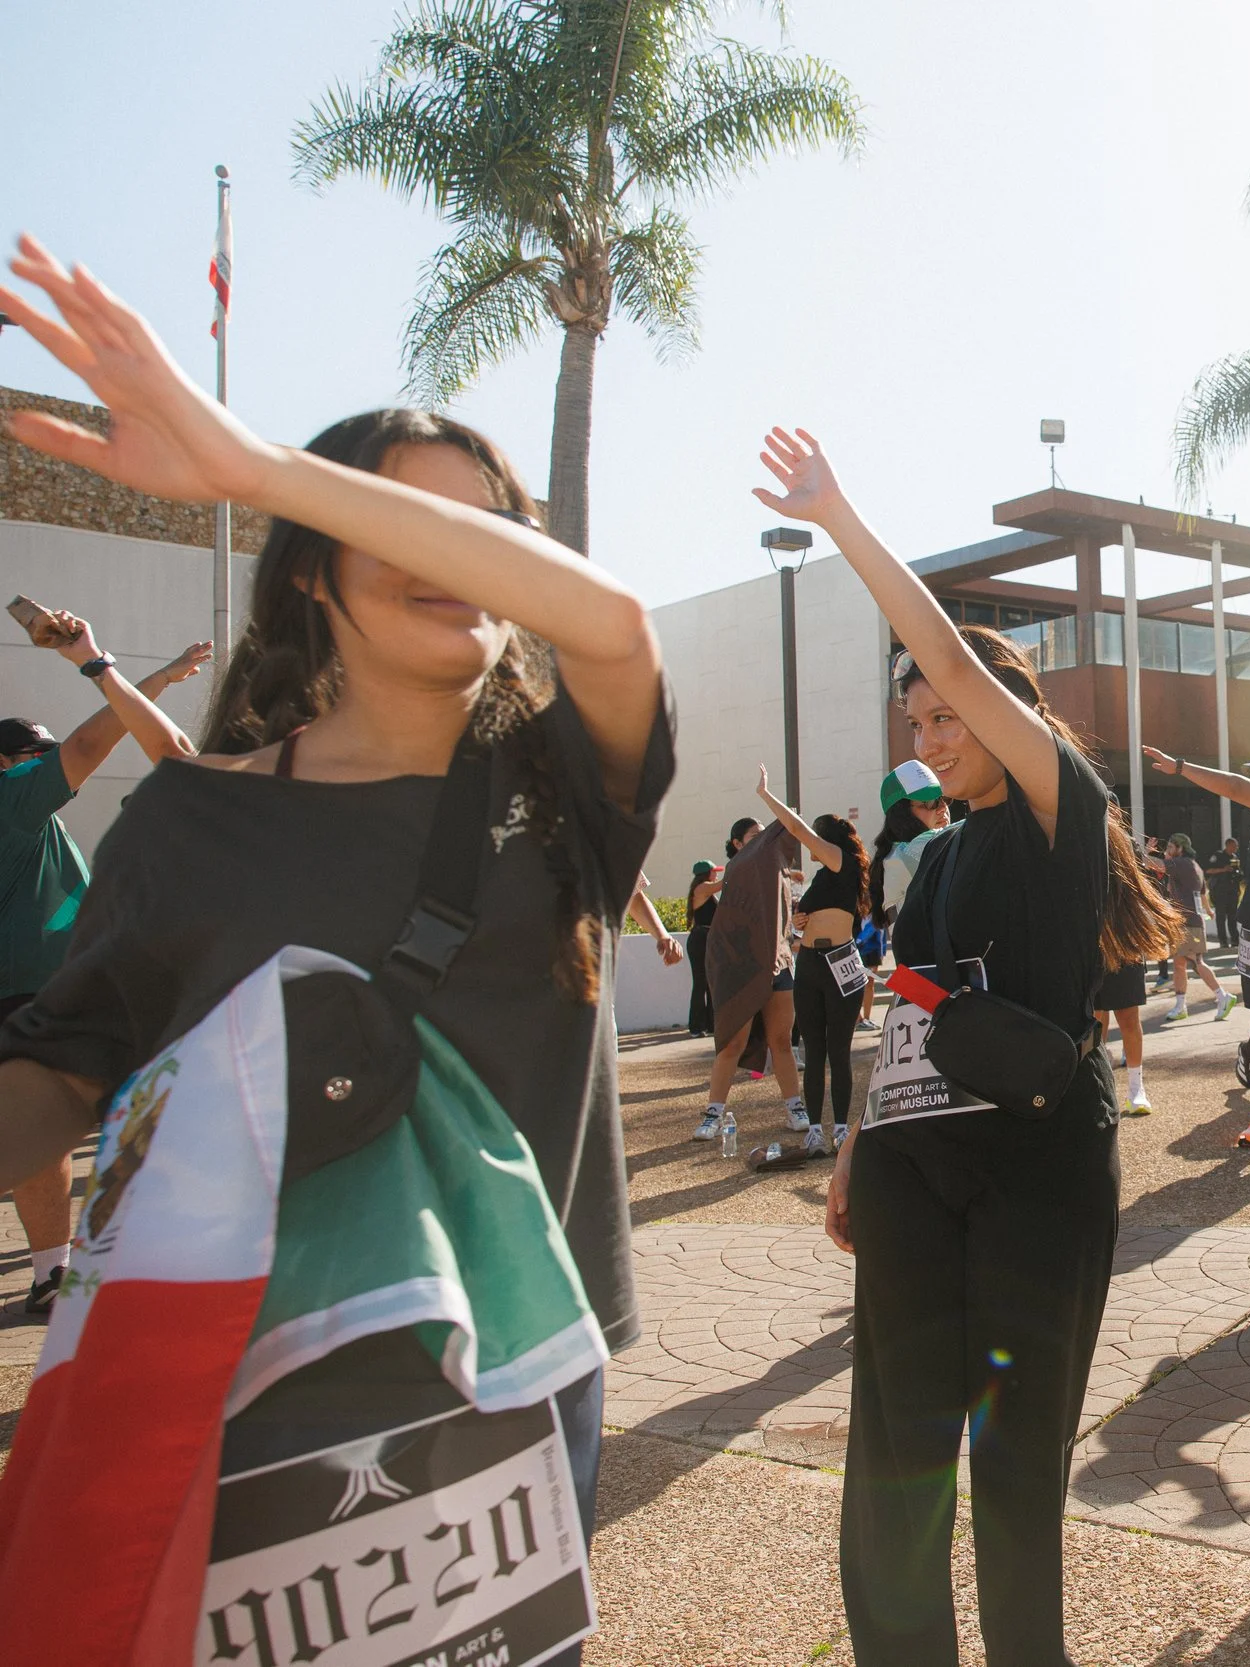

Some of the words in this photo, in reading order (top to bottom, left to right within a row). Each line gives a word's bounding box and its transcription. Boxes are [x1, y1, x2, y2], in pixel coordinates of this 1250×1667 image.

[880, 1083, 922, 1102] COMPTON
[925, 1083, 940, 1092] ART
[940, 1082, 948, 1090] &
[900, 1093, 950, 1110] MUSEUM
[207, 1484, 540, 1667] 90220
[455, 1632, 488, 1662] ART
[490, 1627, 505, 1643] &
